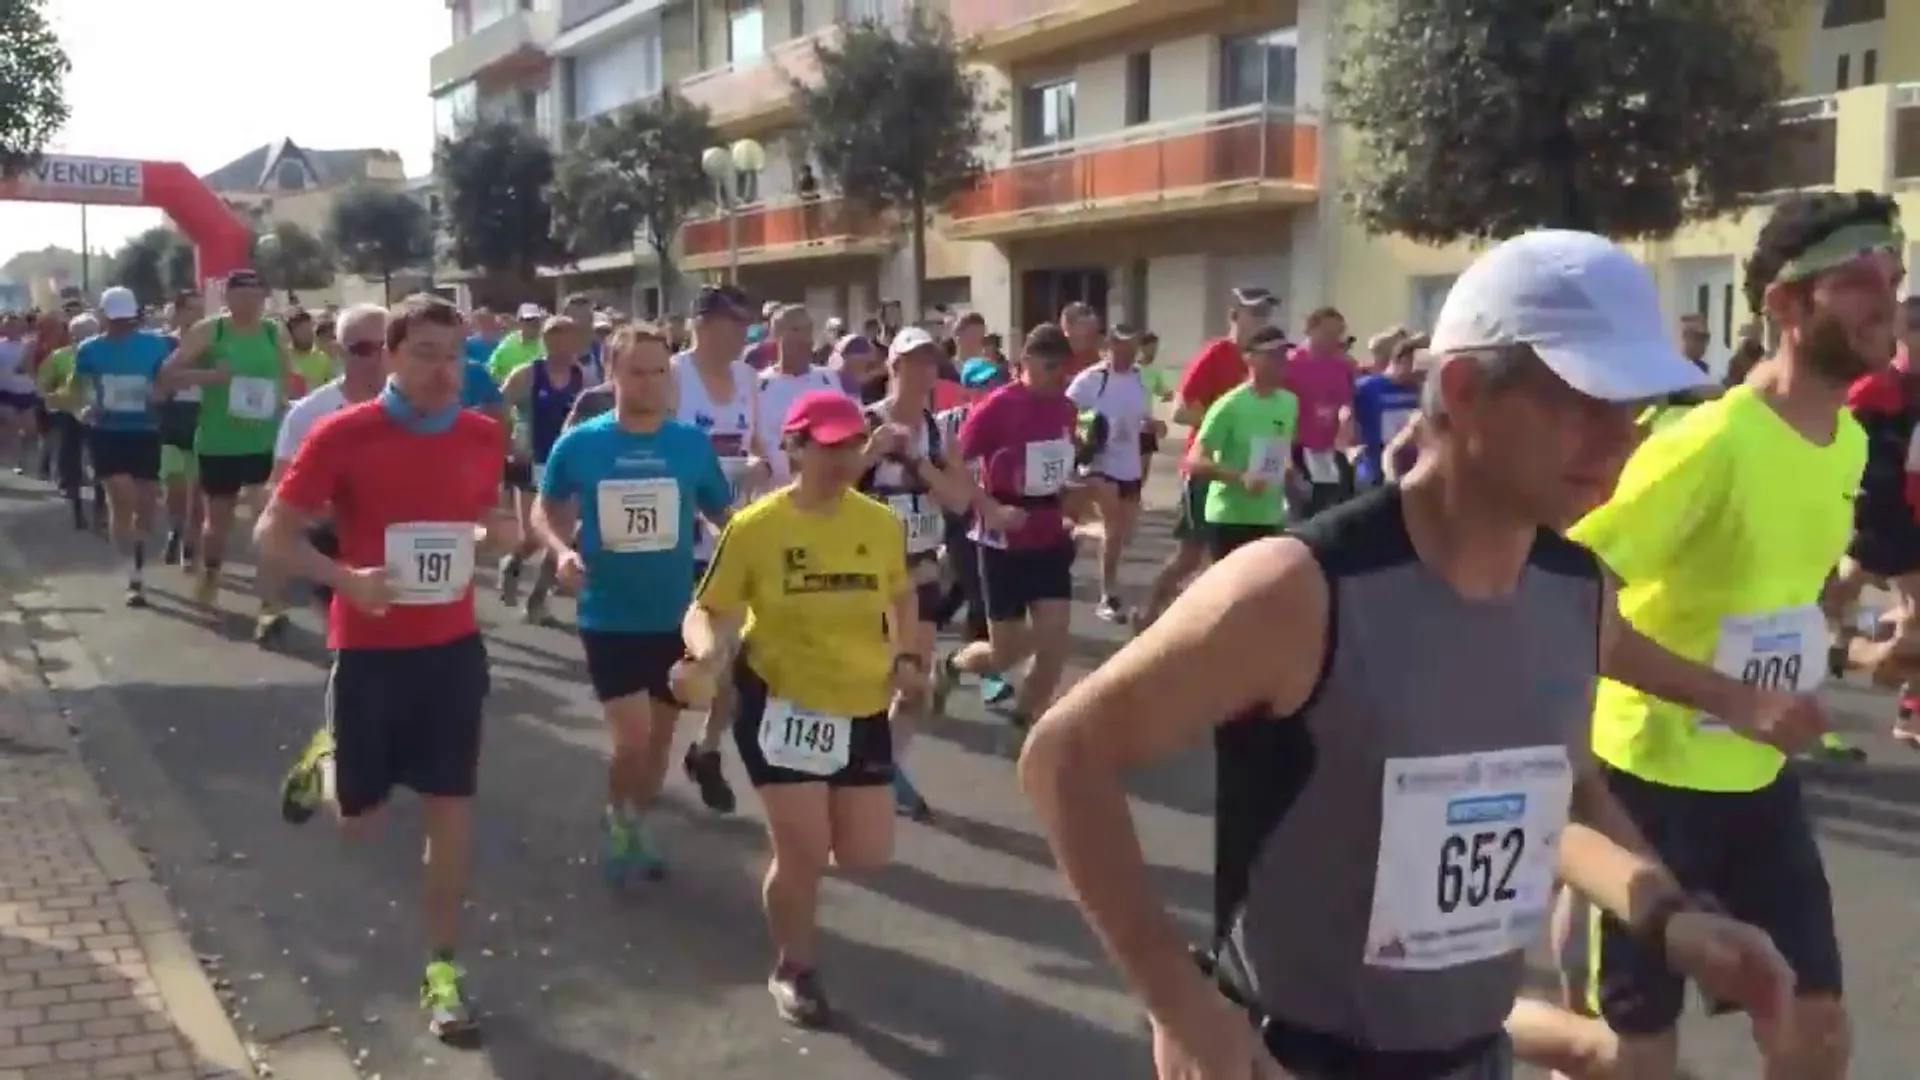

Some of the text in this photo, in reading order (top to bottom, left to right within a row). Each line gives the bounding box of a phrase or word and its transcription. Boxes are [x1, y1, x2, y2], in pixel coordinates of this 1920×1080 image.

[624, 506, 658, 535] 751
[416, 552, 452, 583] 191
[784, 716, 836, 753] 1149
[1437, 827, 1526, 913] 652
